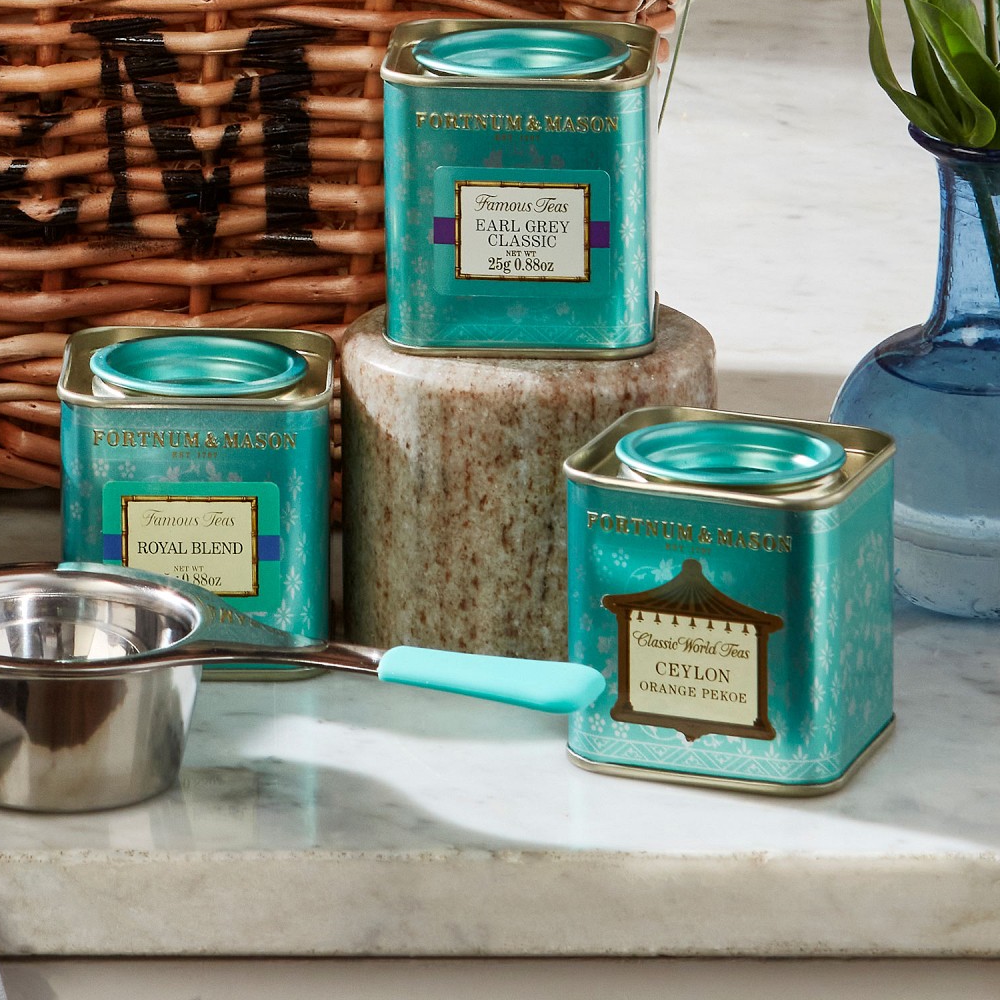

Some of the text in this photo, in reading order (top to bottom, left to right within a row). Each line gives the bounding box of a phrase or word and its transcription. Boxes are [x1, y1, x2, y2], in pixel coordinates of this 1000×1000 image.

[415, 111, 619, 134] FORTNUM & MASON
[474, 193, 569, 214] Famous Teas
[475, 219, 570, 234] EARL GREY
[488, 234, 557, 248] CLASSIC
[488, 257, 554, 275] 25g 0.88oz
[92, 429, 298, 450] FORTNUM & MASON
[141, 509, 235, 528] Famous Teas
[586, 510, 694, 542] FORTNUM
[697, 526, 713, 544] &
[717, 527, 793, 553] MASON
[137, 541, 244, 555] ROYAL BLEND
[182, 573, 222, 587] 088oz
[632, 629, 750, 660] Classic World Teas
[655, 662, 731, 684] CEYLON
[639, 680, 747, 704] ORANGE PEKOE
